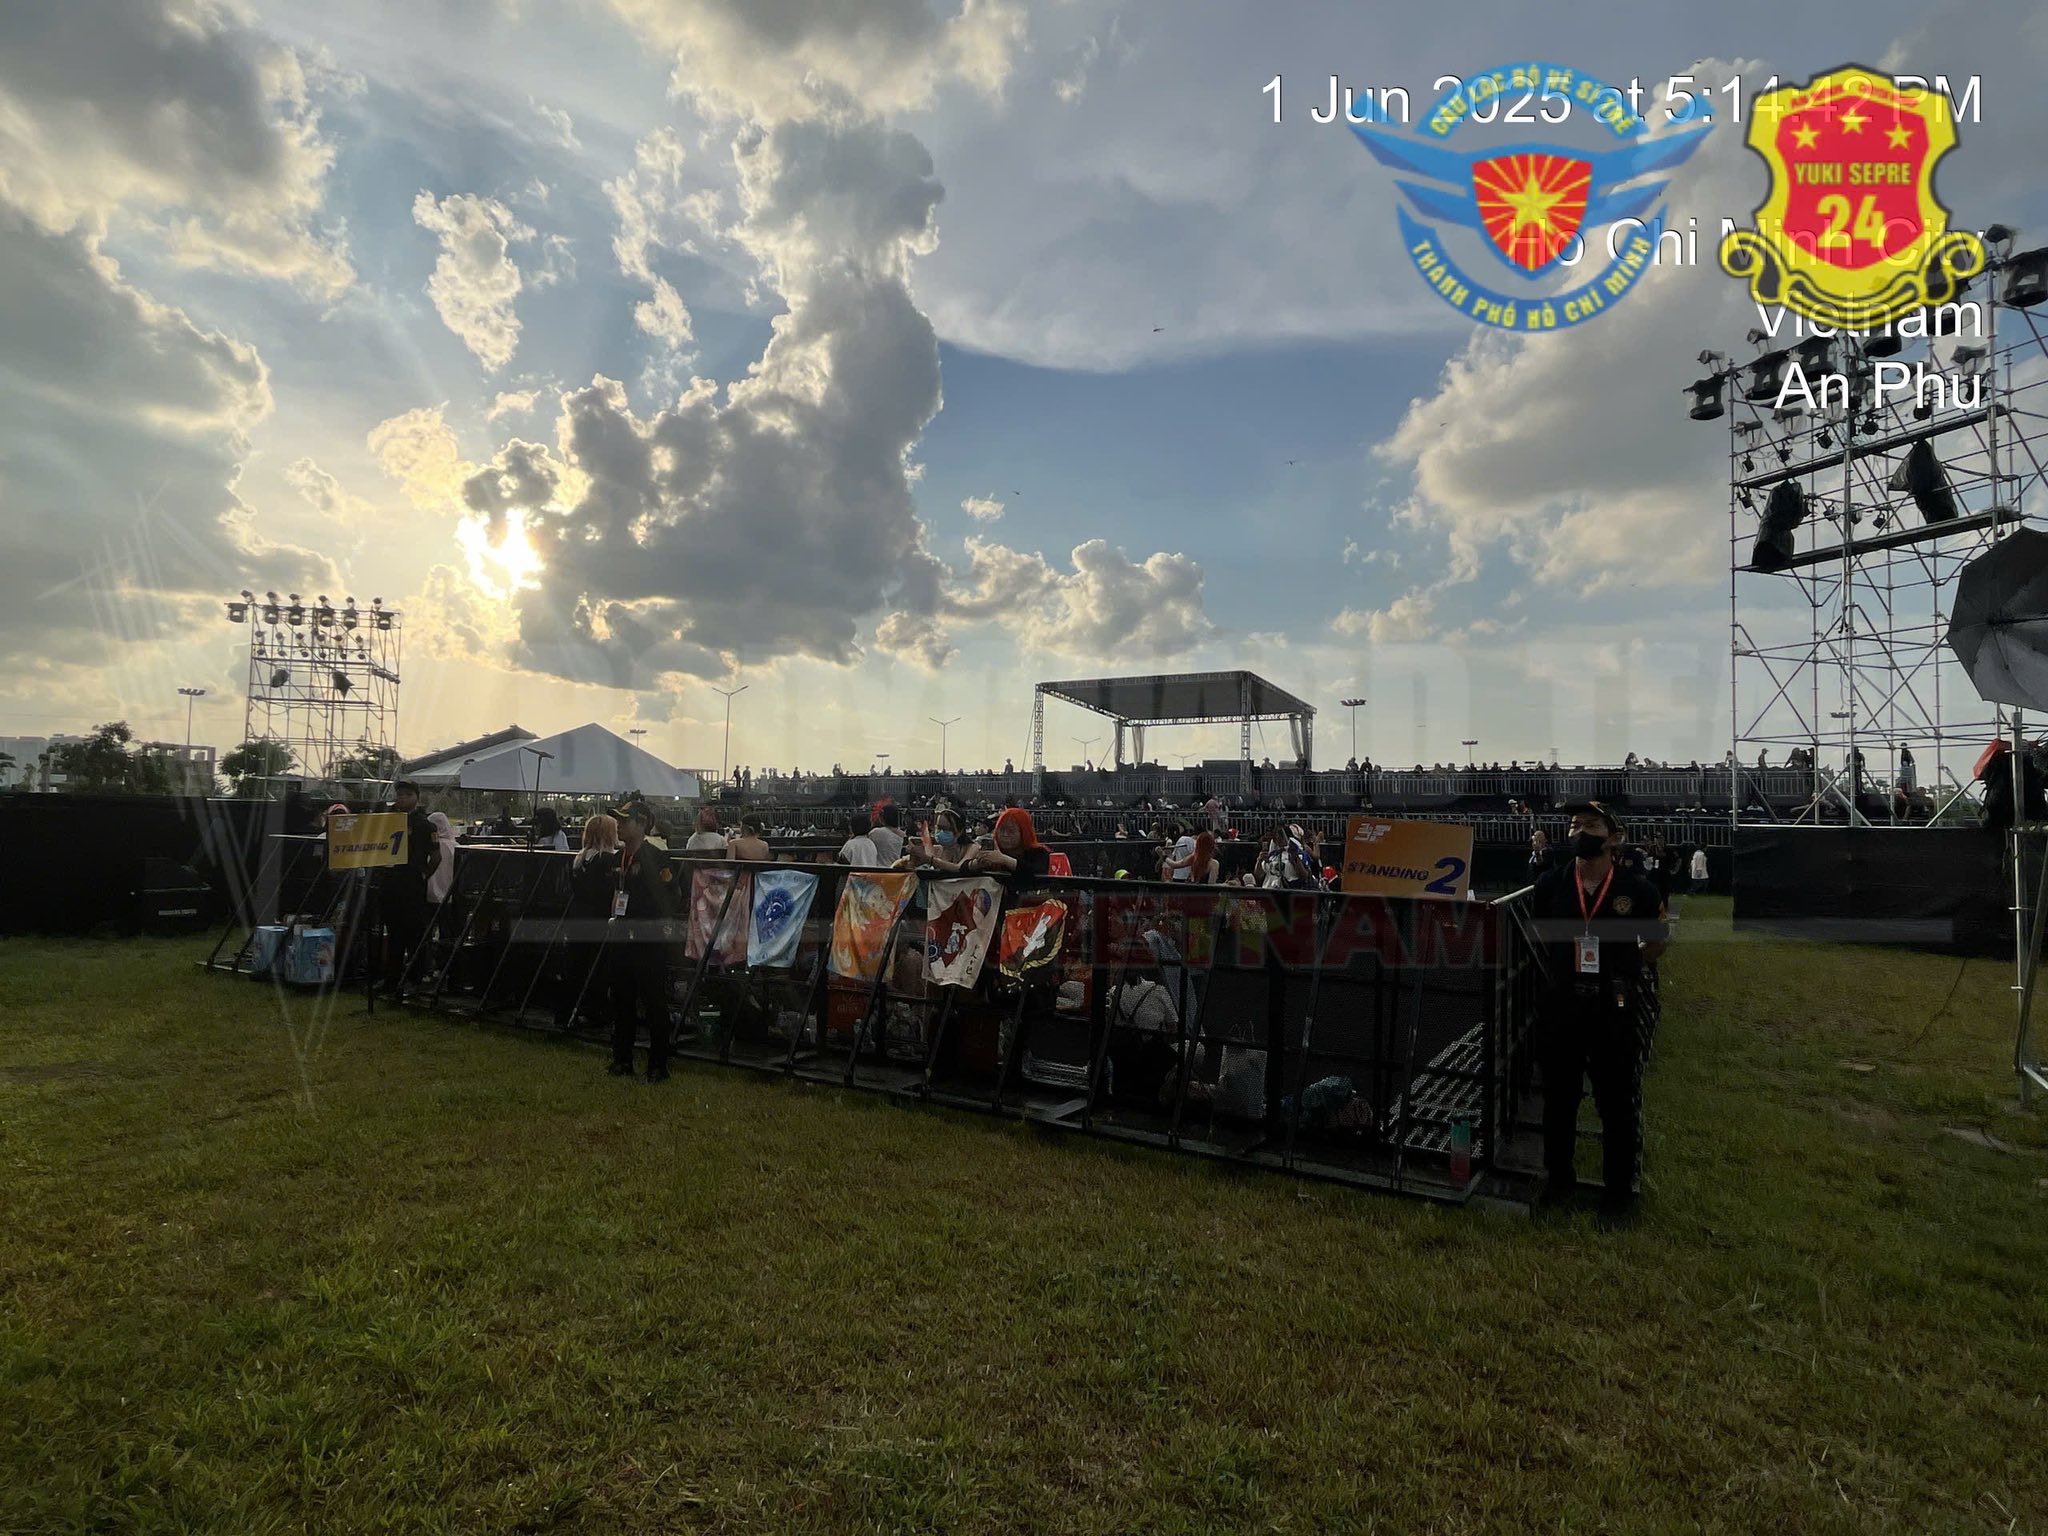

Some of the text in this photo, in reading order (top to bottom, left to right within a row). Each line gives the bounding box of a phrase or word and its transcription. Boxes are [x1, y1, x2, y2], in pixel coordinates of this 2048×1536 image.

[333, 831, 405, 856] STANDING 1
[1347, 857, 1467, 895] STANDING 2
